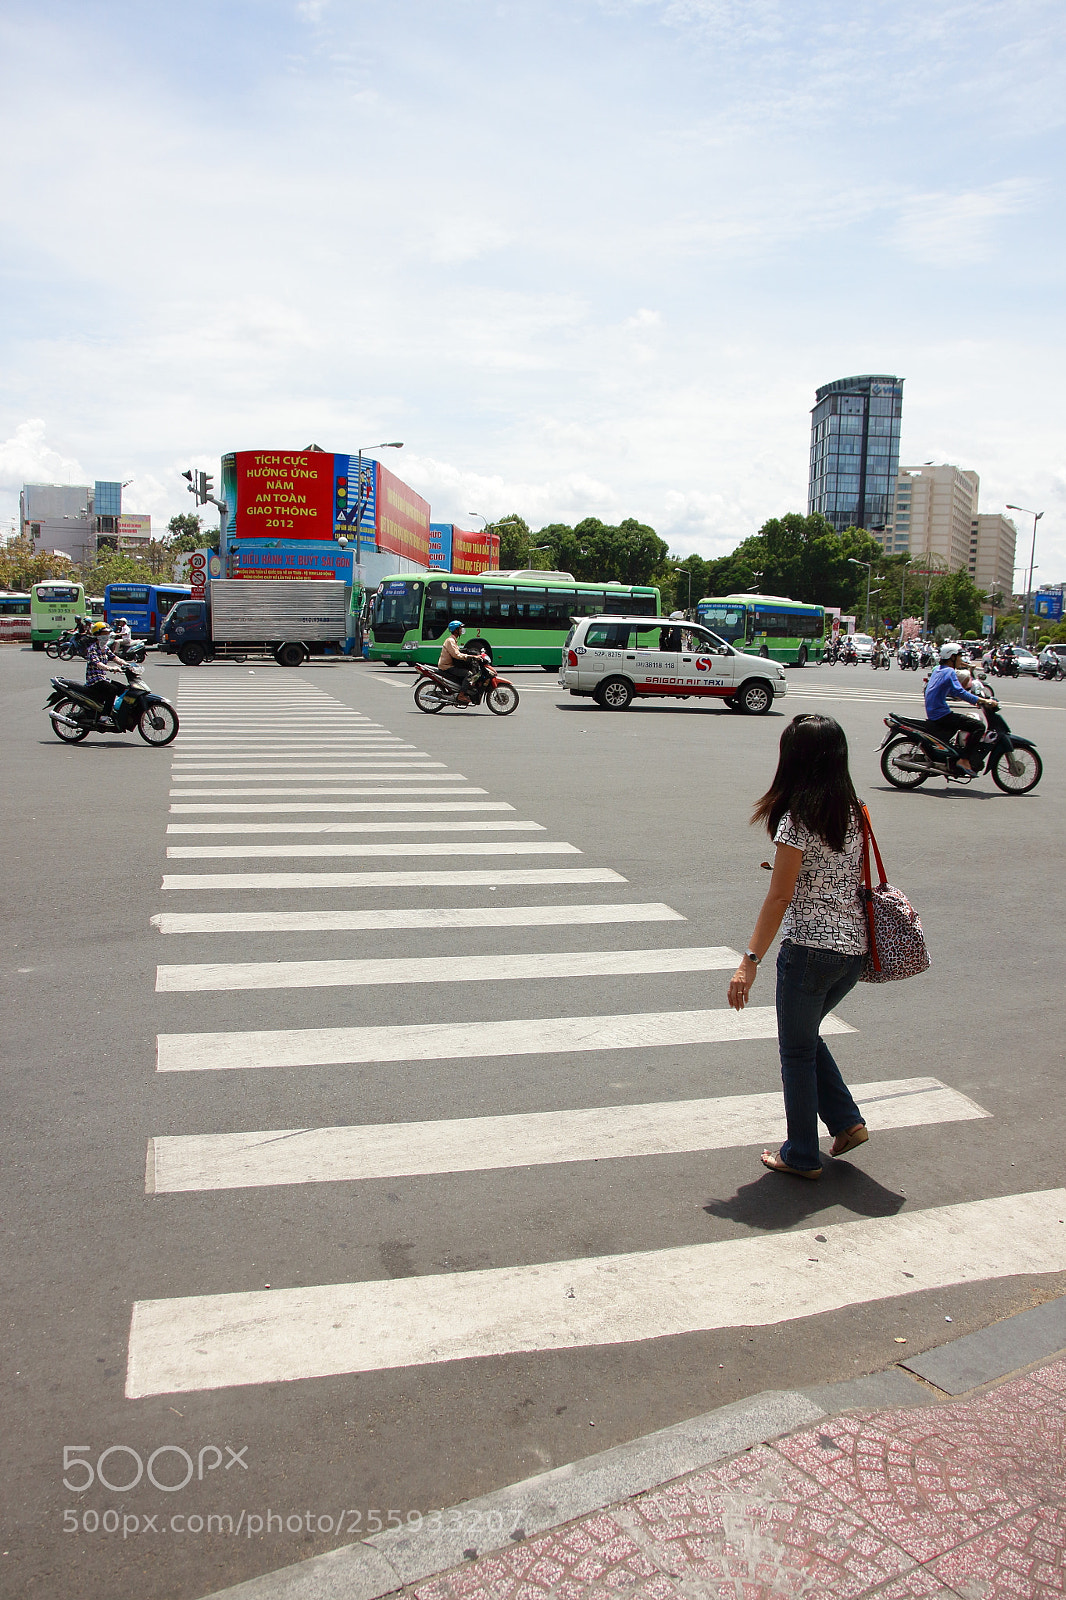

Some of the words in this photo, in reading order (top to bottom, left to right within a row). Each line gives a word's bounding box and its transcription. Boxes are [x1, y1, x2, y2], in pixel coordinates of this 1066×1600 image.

[254, 454, 280, 464] TÍCH
[283, 456, 308, 467] CỰC
[246, 467, 288, 478] HƯỞNG
[291, 468, 318, 478] ỨNG
[266, 480, 294, 490] NĂM
[256, 494, 271, 502] AN
[273, 493, 306, 503] TOÀN
[246, 506, 272, 515] GIAO
[274, 506, 317, 516] THÔNG
[266, 519, 294, 528] 2012
[261, 553, 282, 565] HÀNH
[285, 555, 295, 565] XE
[477, 629, 480, 637] 2
